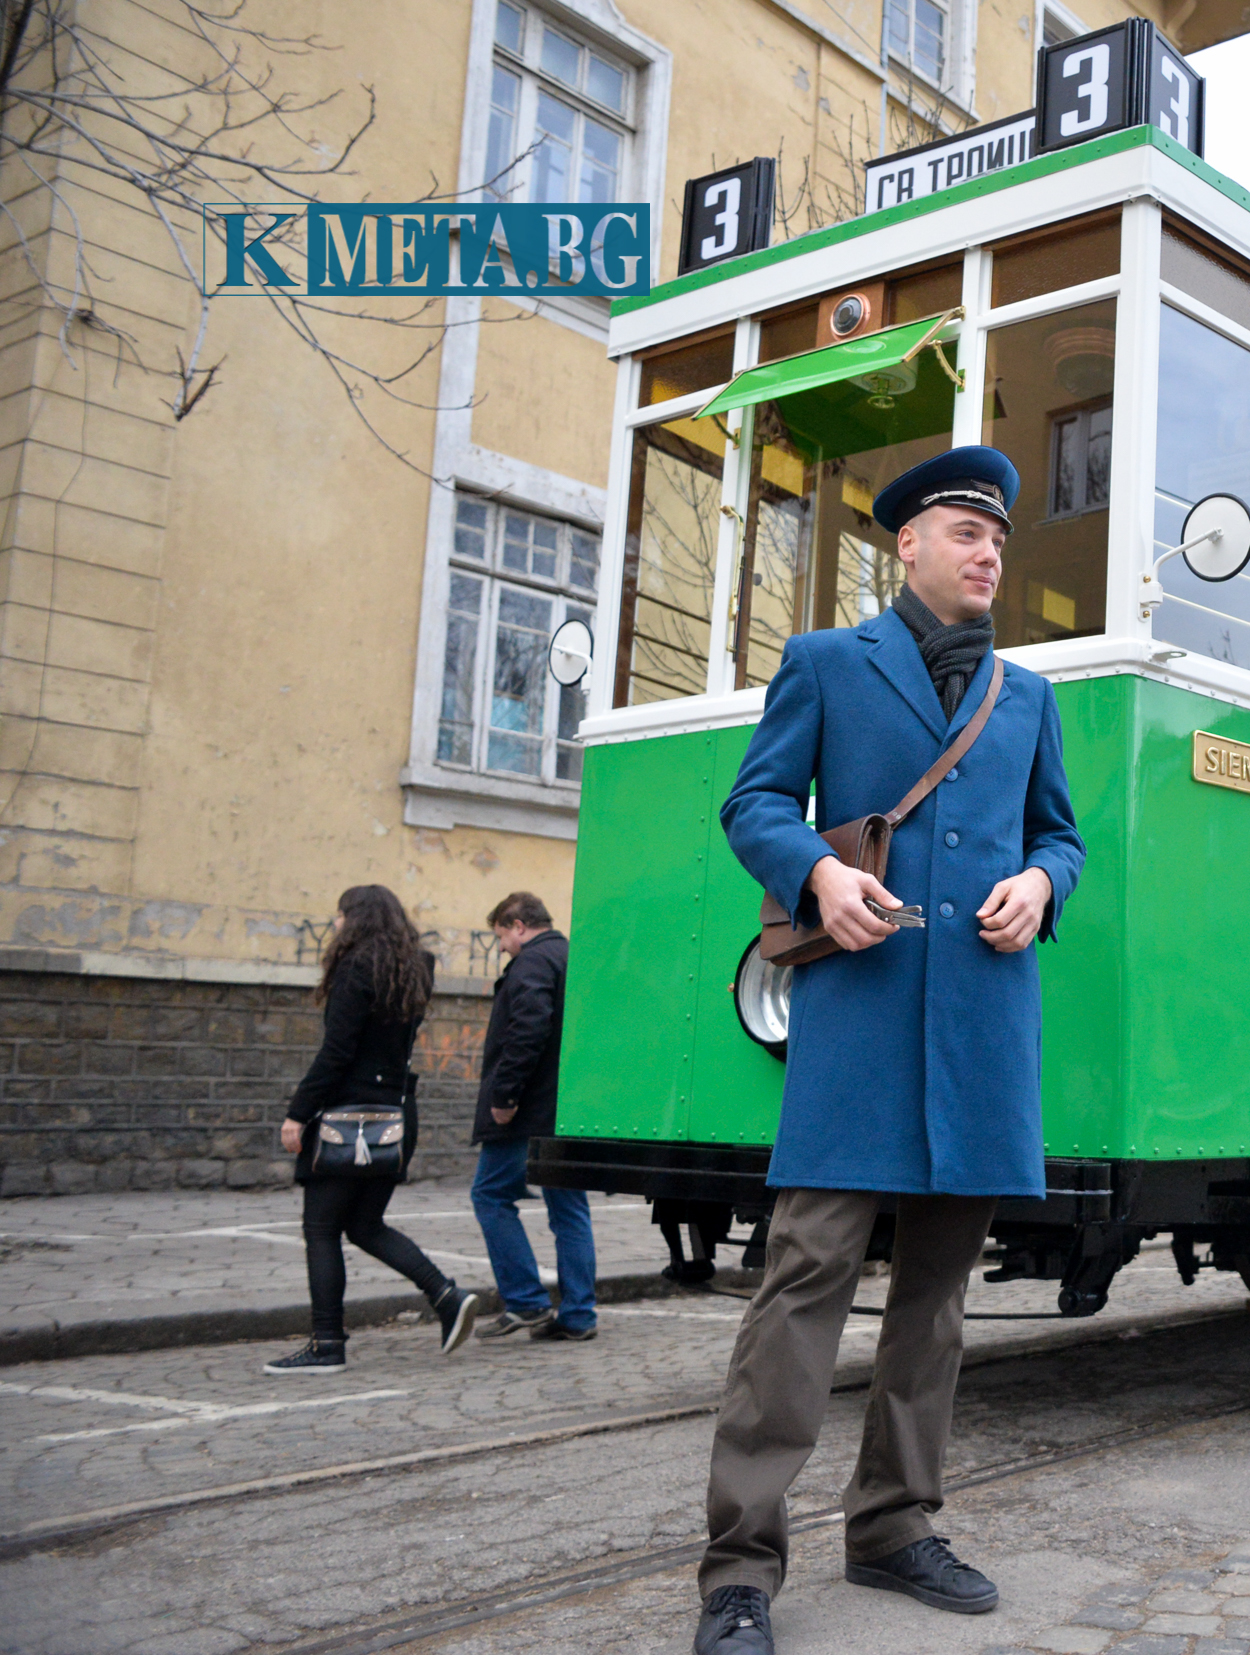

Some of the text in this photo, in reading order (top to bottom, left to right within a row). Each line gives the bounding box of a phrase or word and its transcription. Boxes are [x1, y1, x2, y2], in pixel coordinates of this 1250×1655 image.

[1060, 44, 1110, 137] 3
[1160, 55, 1190, 150] 3
[701, 177, 741, 260] 3
